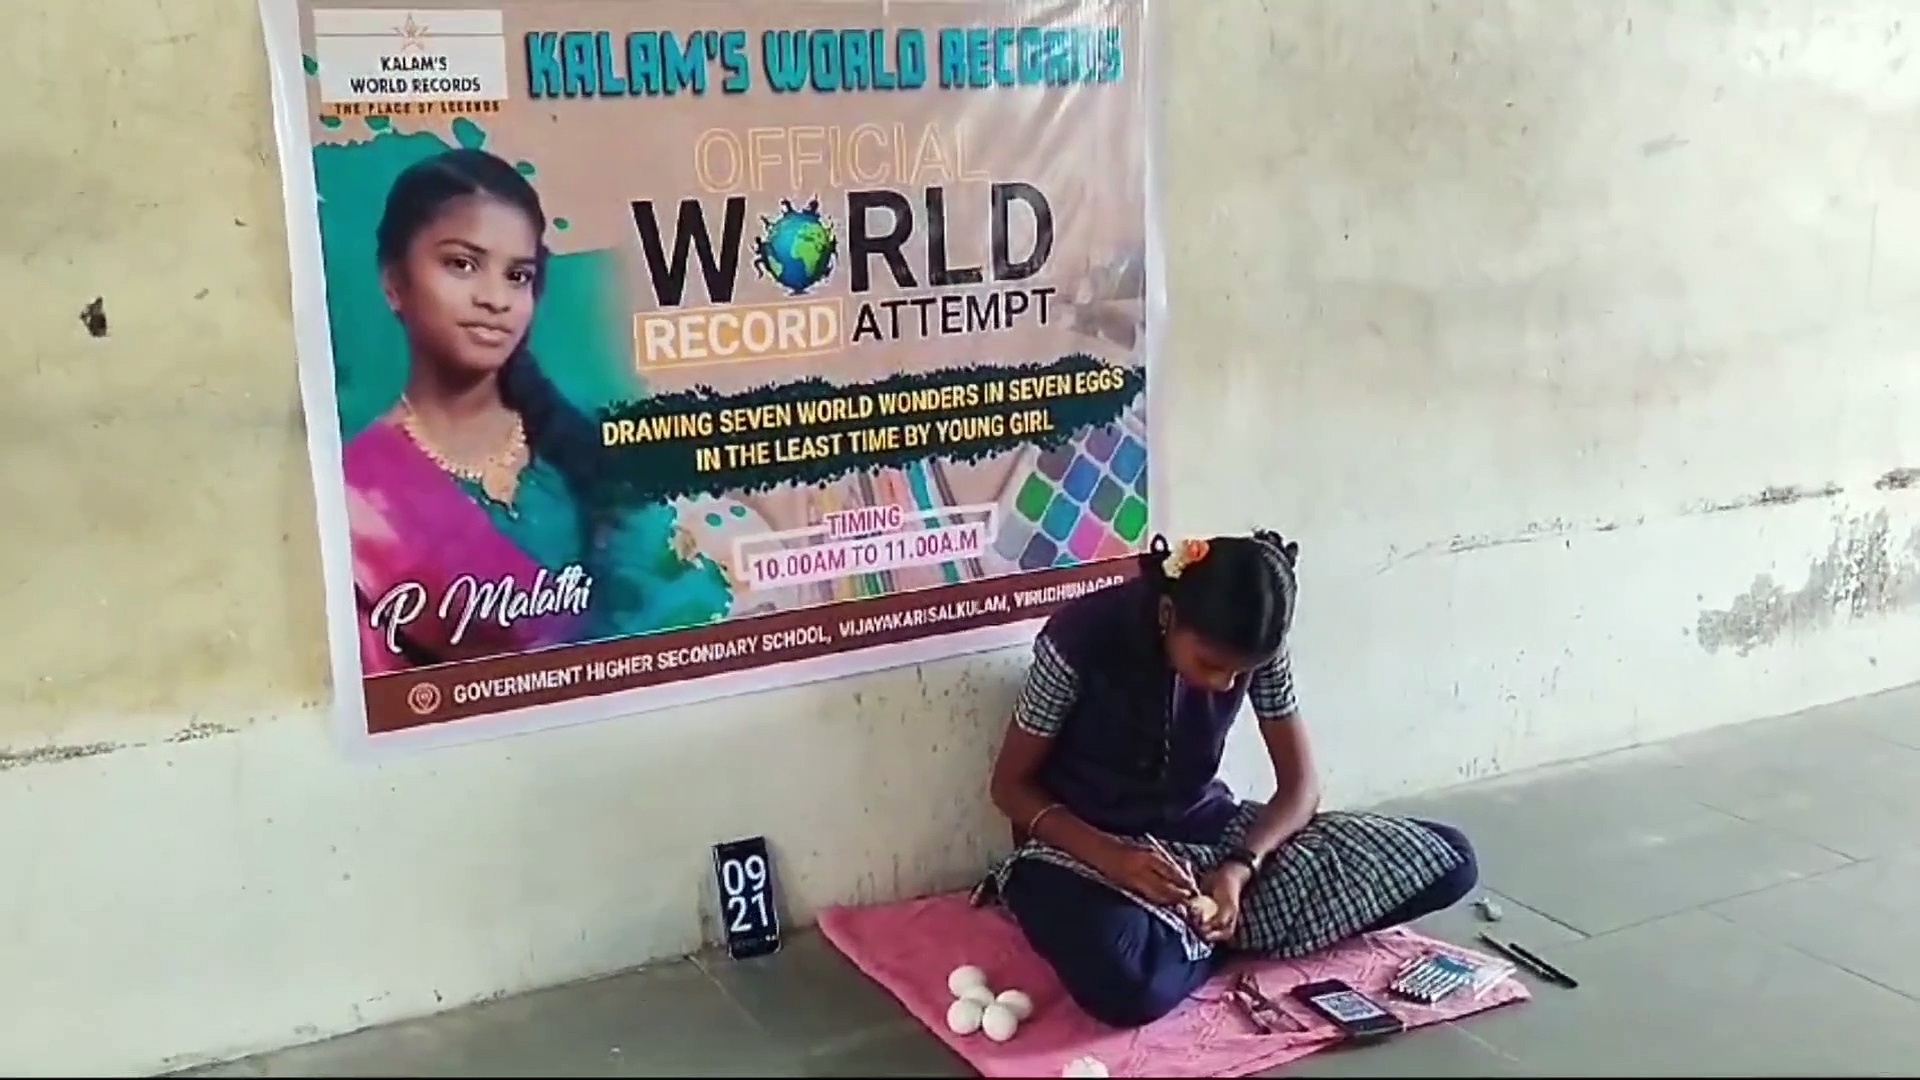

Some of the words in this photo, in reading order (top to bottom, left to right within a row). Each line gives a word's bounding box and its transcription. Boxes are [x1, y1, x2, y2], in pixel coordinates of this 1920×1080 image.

[350, 78, 406, 94] WORLD
[413, 77, 481, 93] RECORDS
[380, 56, 447, 71] KALAM'S
[525, 29, 750, 98] KALAM'S
[763, 27, 926, 91] WORLD
[334, 102, 360, 114] THE
[368, 102, 410, 114] PLACE
[694, 122, 990, 193] OFFICIAL
[644, 306, 836, 361] RECORD
[852, 288, 1055, 342] ATTEMPT
[602, 412, 713, 447] DRAWING
[719, 402, 792, 434] SEVEN
[796, 392, 873, 425] WORLD
[878, 382, 979, 416] WONDERS
[984, 380, 1004, 402] IN
[1009, 373, 1073, 401] SEVEN
[1075, 366, 1124, 395] EGGS
[696, 446, 721, 472] IN
[725, 440, 772, 469] THE
[775, 432, 843, 463] LEAST
[847, 426, 900, 454] TIME
[904, 422, 931, 447] BY
[935, 414, 1004, 443] YOUNG
[1009, 409, 1055, 436] GIRL
[826, 505, 901, 534] TIMING
[753, 546, 846, 582] 10.00AM
[850, 542, 878, 567] TO
[884, 528, 978, 561] 11.00A.M
[370, 581, 427, 654] P
[438, 565, 593, 646] Malathi
[452, 663, 583, 704] GOVERNMENT
[585, 650, 654, 680] HIGHER
[656, 635, 758, 671] SECONDARY
[761, 624, 832, 652] SCHOOL,
[723, 854, 766, 896] 09
[728, 892, 768, 932] 21
